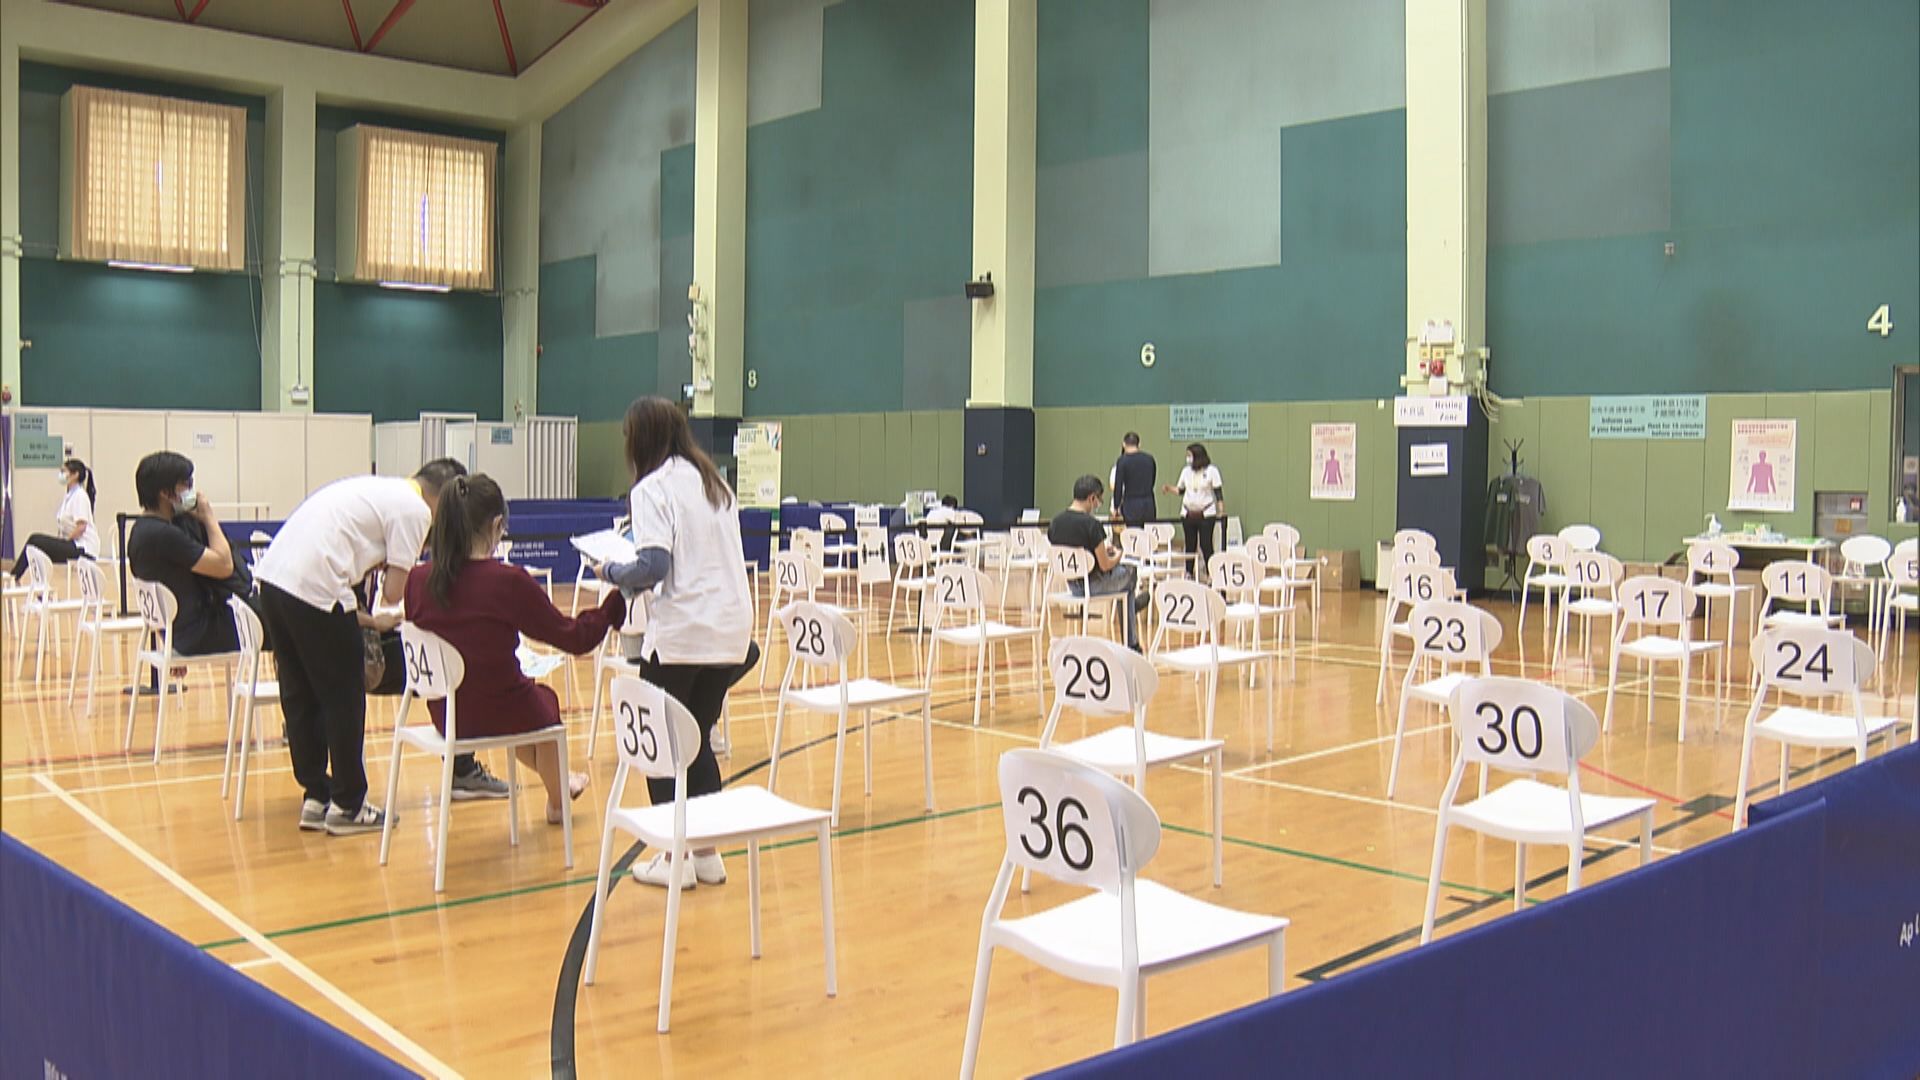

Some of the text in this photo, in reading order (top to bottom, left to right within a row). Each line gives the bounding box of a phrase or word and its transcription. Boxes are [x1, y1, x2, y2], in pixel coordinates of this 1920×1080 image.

[1867, 303, 1893, 336] 4
[1141, 343, 1155, 368] 6
[748, 369, 757, 388] 8
[900, 540, 916, 560] 13
[1018, 530, 1025, 545] 6
[1130, 534, 1137, 552] 7
[1058, 552, 1079, 574] 14
[1258, 544, 1267, 563] 8
[1542, 543, 1553, 560] 3
[1703, 551, 1714, 568] 4
[80, 570, 93, 596] 31
[778, 560, 798, 587] 20
[1219, 562, 1245, 587] 15
[1575, 560, 1600, 582] 10
[1780, 571, 1806, 594] 11
[942, 575, 966, 603] 21
[1405, 574, 1432, 600] 16
[139, 590, 158, 622] 32
[1164, 593, 1196, 625] 22
[1635, 590, 1669, 618] 17
[792, 616, 825, 656] 28
[1423, 616, 1466, 652] 23
[405, 641, 433, 686] 34
[1776, 640, 1833, 682] 24
[1062, 654, 1111, 701] 29
[620, 700, 658, 762] 35
[1475, 701, 1543, 759] 30
[1017, 786, 1094, 871] 36
[1900, 921, 1913, 947] Ap
